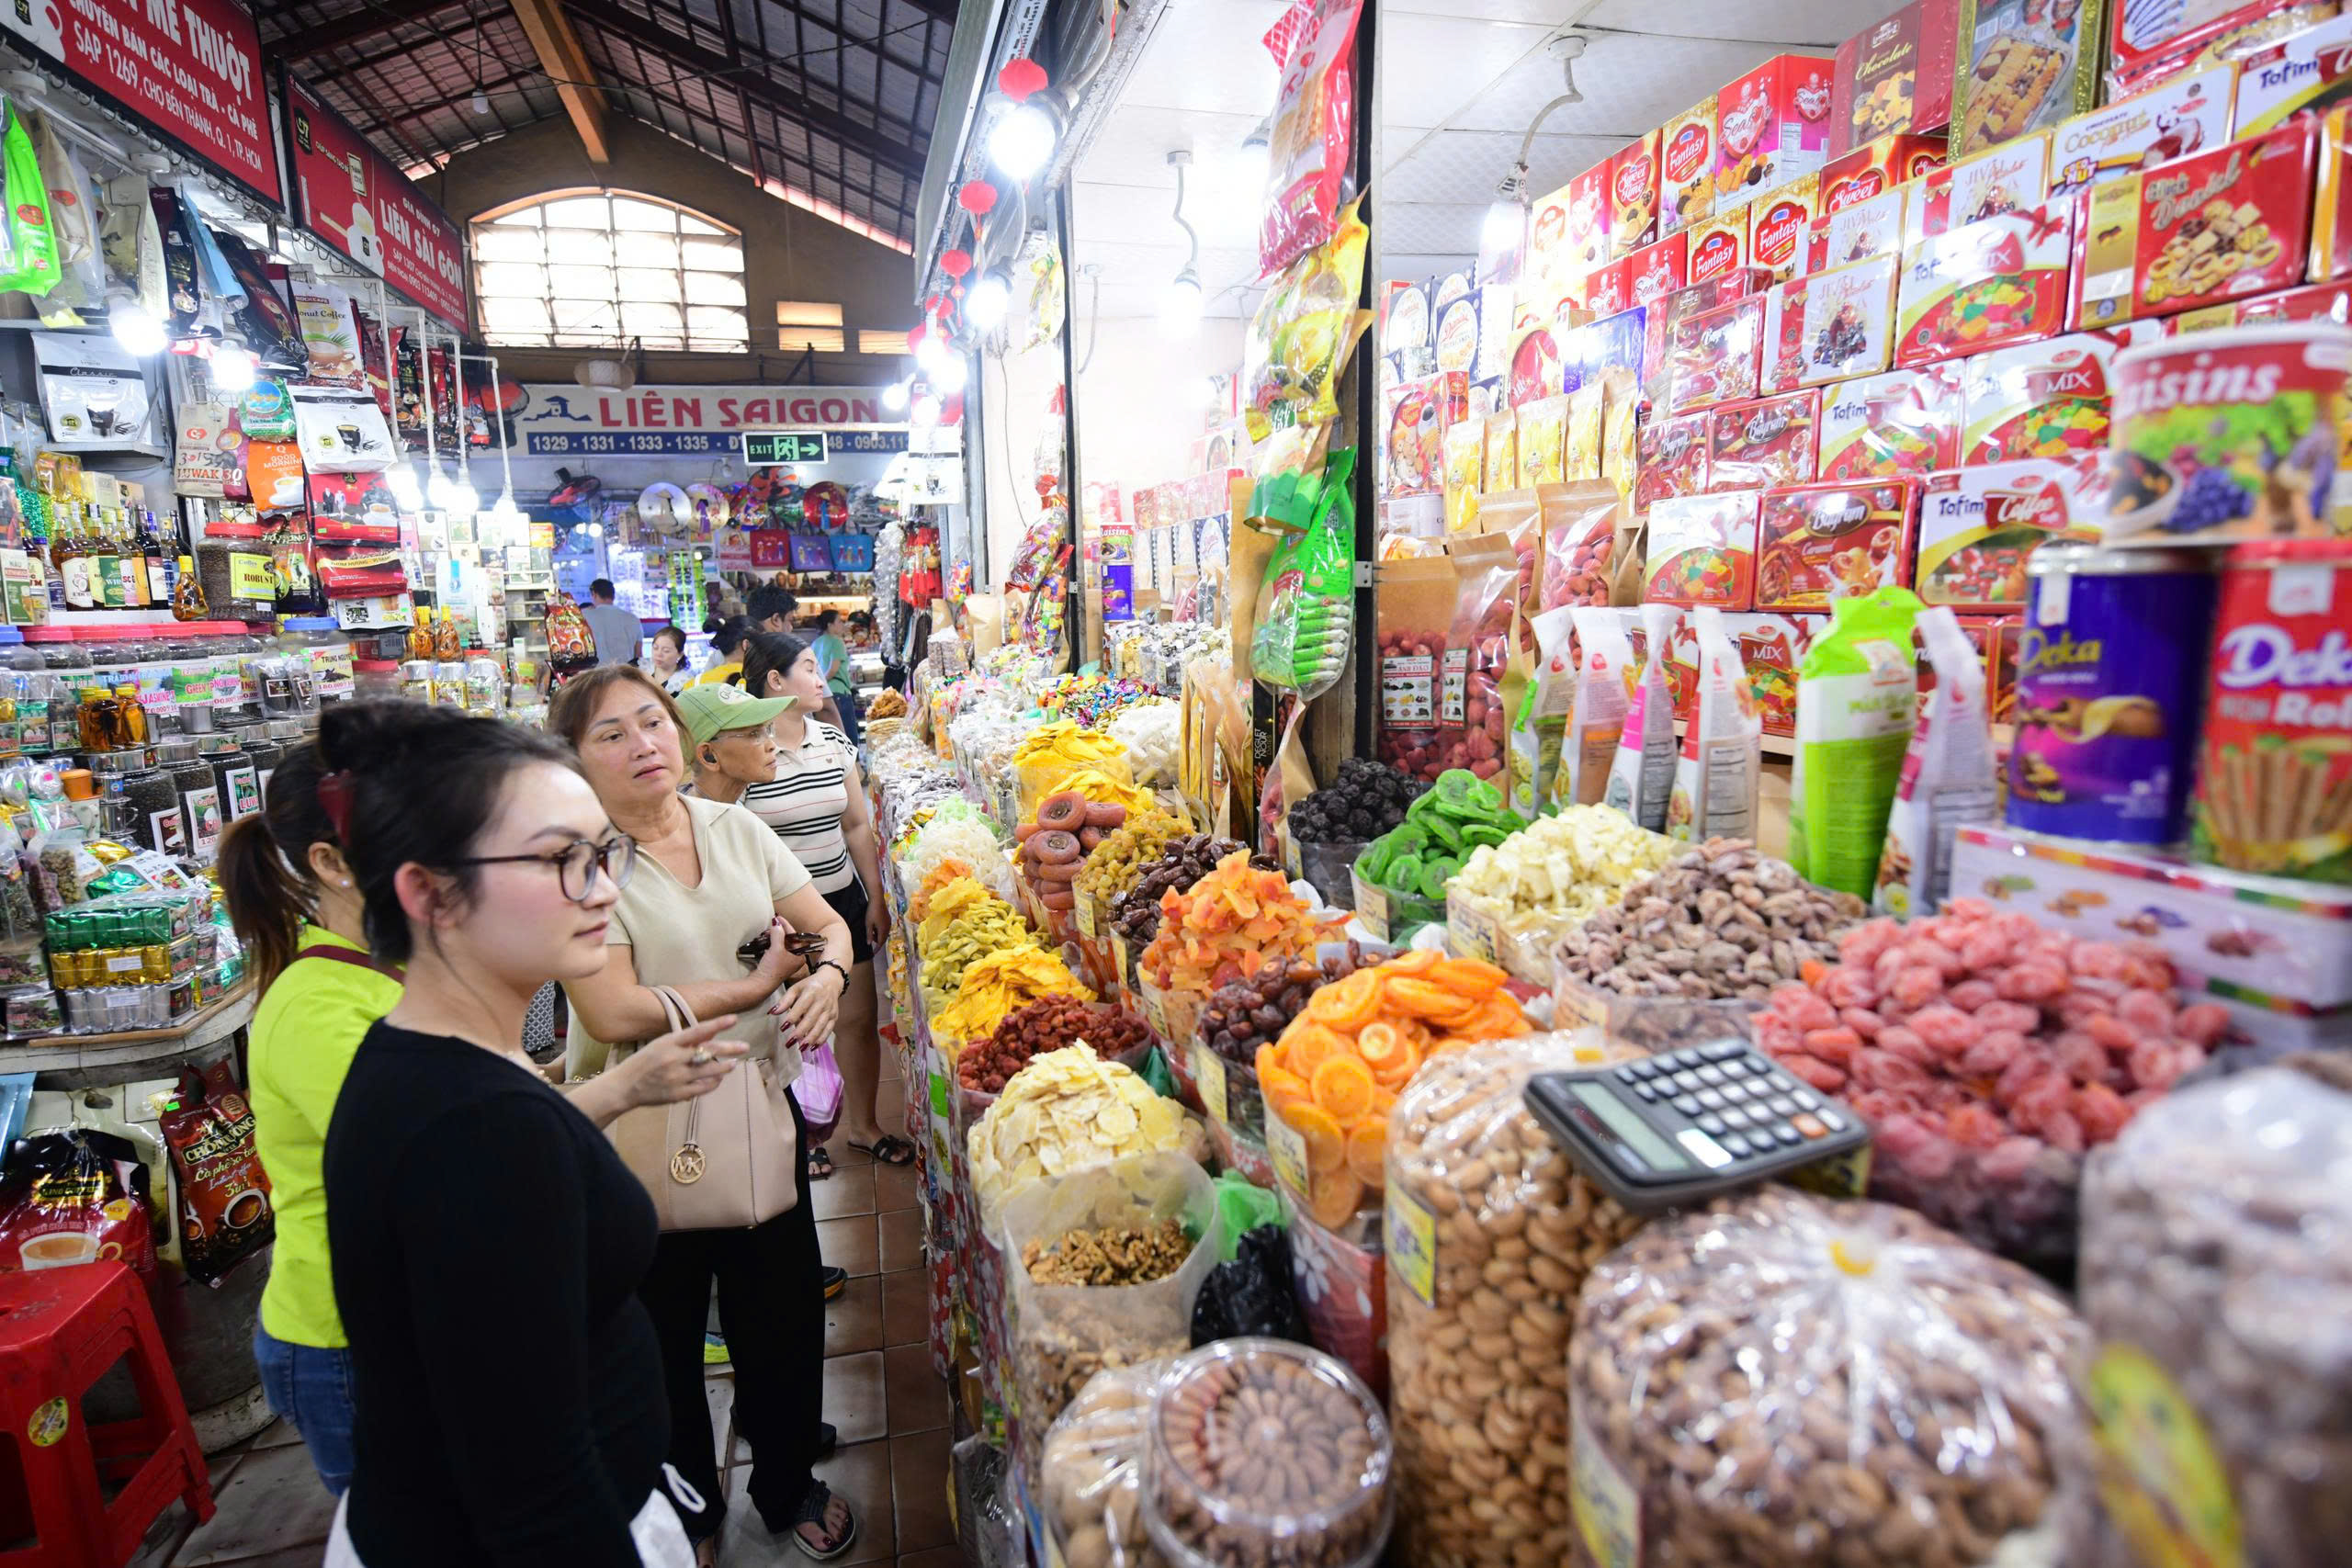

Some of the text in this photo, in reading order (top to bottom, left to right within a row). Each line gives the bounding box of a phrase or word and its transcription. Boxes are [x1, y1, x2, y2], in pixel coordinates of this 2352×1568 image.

[184, 4, 253, 107] THUỘT
[1855, 41, 1914, 81] Chocolate
[74, 20, 102, 64] SẠP
[143, 76, 165, 110] CHỢ
[165, 88, 185, 121] BẾN
[245, 146, 264, 173] HCM
[121, 24, 148, 62] BÁN
[150, 46, 172, 79] CÁC
[173, 62, 198, 100] LOẠI
[198, 82, 220, 113] TRÀ
[227, 103, 241, 128] CÀ
[241, 112, 258, 141] PHÊ
[1669, 133, 1707, 173] Fantasy
[1829, 180, 1877, 213] Sweet
[379, 197, 464, 293] LIÊN SÀI GÒN
[1759, 215, 1804, 252] Fantasy
[1696, 243, 1735, 278] Fantasy
[320, 310, 346, 321] Coffee
[2045, 369, 2093, 393] MIX
[599, 389, 879, 428] LIÊN SAIGON
[270, 454, 296, 464] GOOD
[533, 435, 569, 452] 1329
[582, 435, 616, 452] 1331
[628, 435, 663, 452] 1333
[675, 435, 709, 452] 1335
[750, 444, 773, 455] EXIT
[177, 468, 220, 479] LUWAK
[1997, 493, 2055, 523] Coffee
[243, 572, 274, 585] ROBUST
[1752, 644, 1783, 662] MIX
[186, 682, 207, 694] GREEN
[2273, 692, 2352, 728] Rol
[240, 795, 258, 809] LUW
